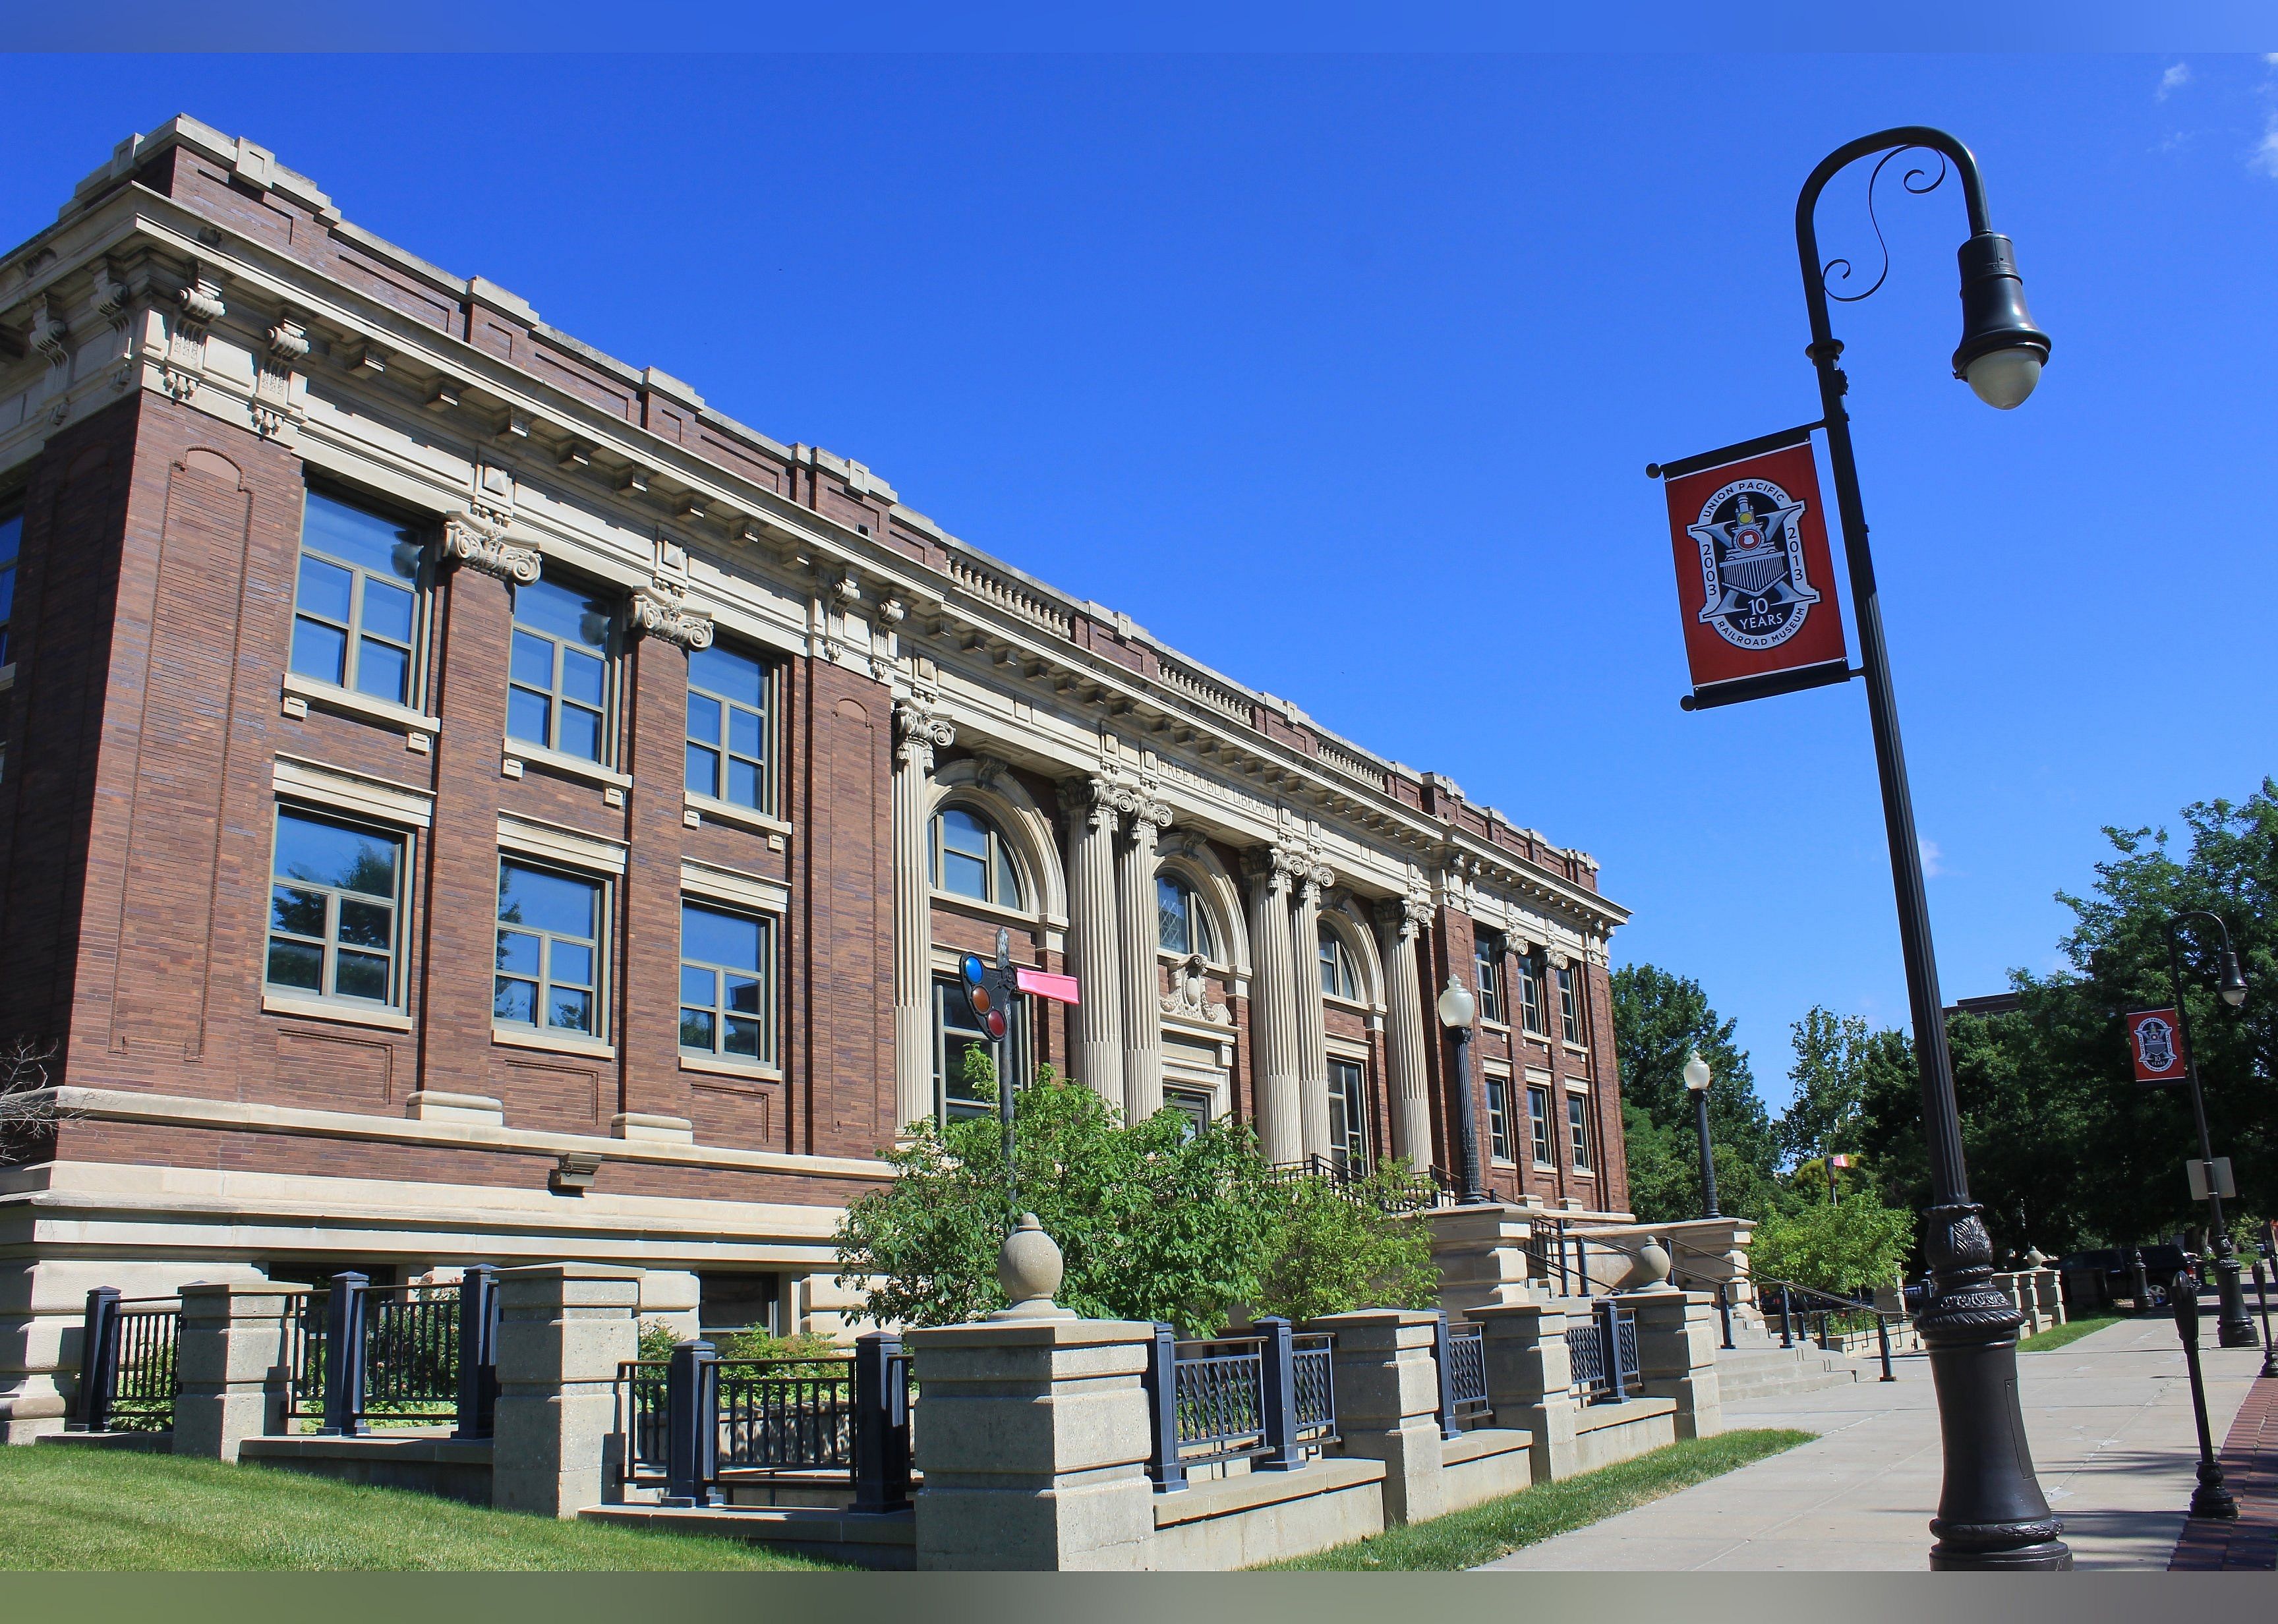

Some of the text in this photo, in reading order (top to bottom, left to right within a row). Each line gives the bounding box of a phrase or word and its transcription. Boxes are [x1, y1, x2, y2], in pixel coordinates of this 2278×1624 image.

[1703, 482, 1784, 517] UNION PACIFIC
[1703, 544, 1717, 596] 2003
[1787, 527, 1803, 581] 2013
[1717, 607, 1805, 646] RAILROAD MUSEUM
[1739, 613, 1783, 630] YEARS
[1747, 598, 1768, 616] 10
[1159, 759, 1276, 819] FREE PUBLIC LIBRARY
